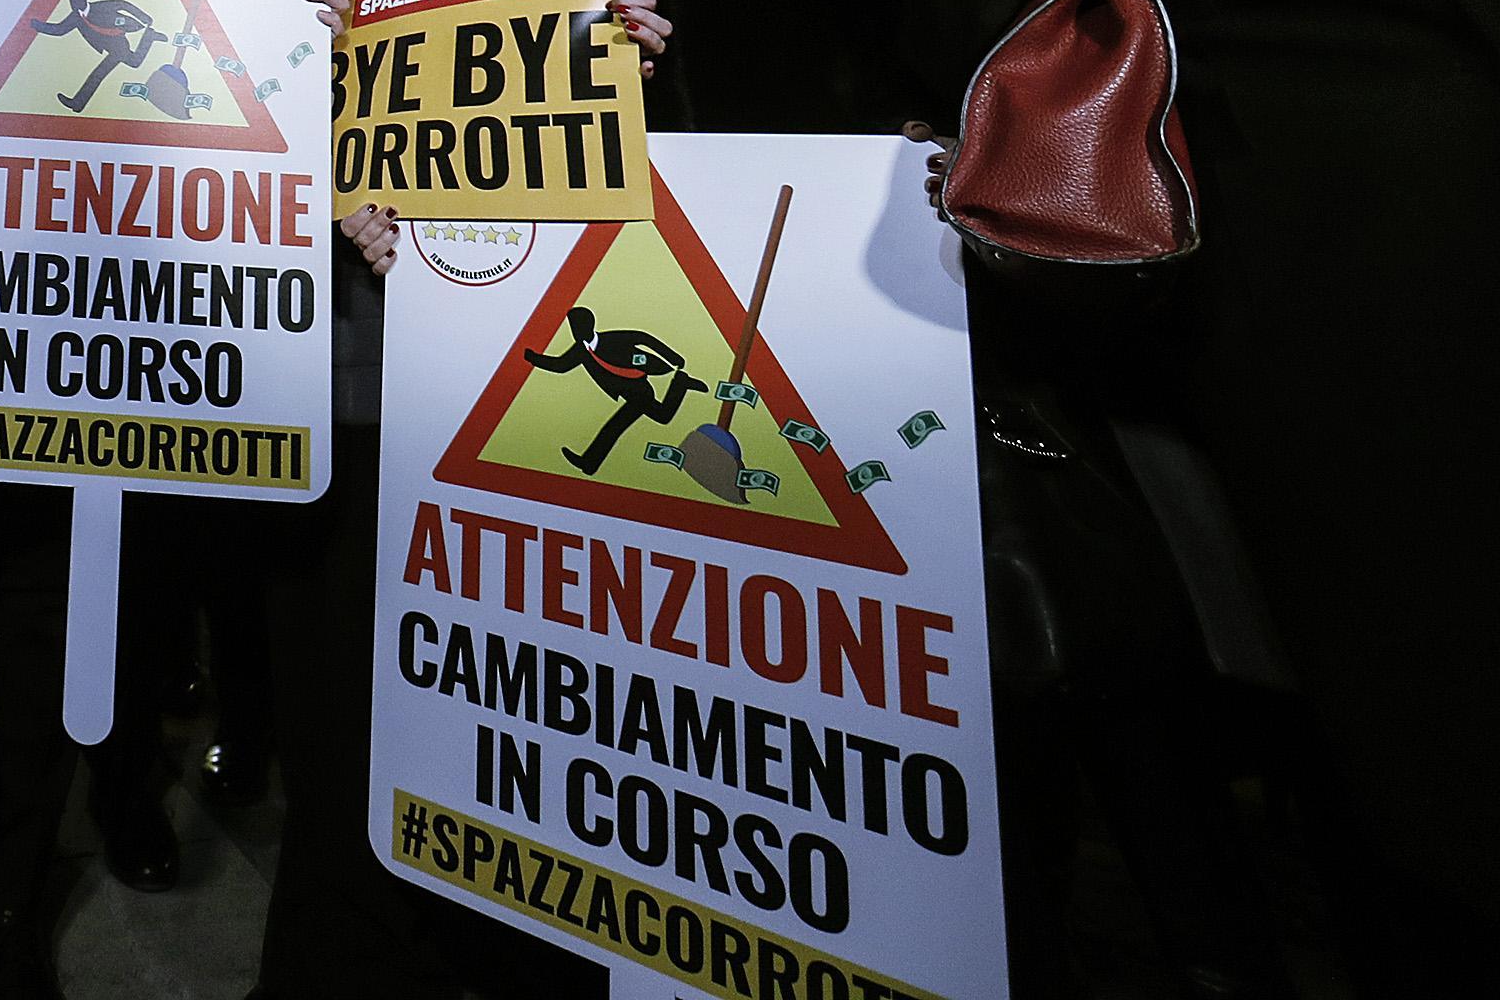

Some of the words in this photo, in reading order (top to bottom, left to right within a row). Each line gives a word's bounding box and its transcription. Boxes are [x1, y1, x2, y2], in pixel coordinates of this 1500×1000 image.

[452, 10, 618, 108] BYE
[332, 110, 626, 195] ORROTTI
[429, 251, 514, 281] ILBLOGDELLESTELLE.IT
[45, 330, 244, 409] CORSO
[402, 499, 960, 729] ATTENZIONE
[398, 610, 970, 857] CAMBIAMENTO
[400, 801, 922, 1000] #SPAZZACORRO
[475, 723, 542, 826] IN
[565, 756, 851, 935] CORSO
